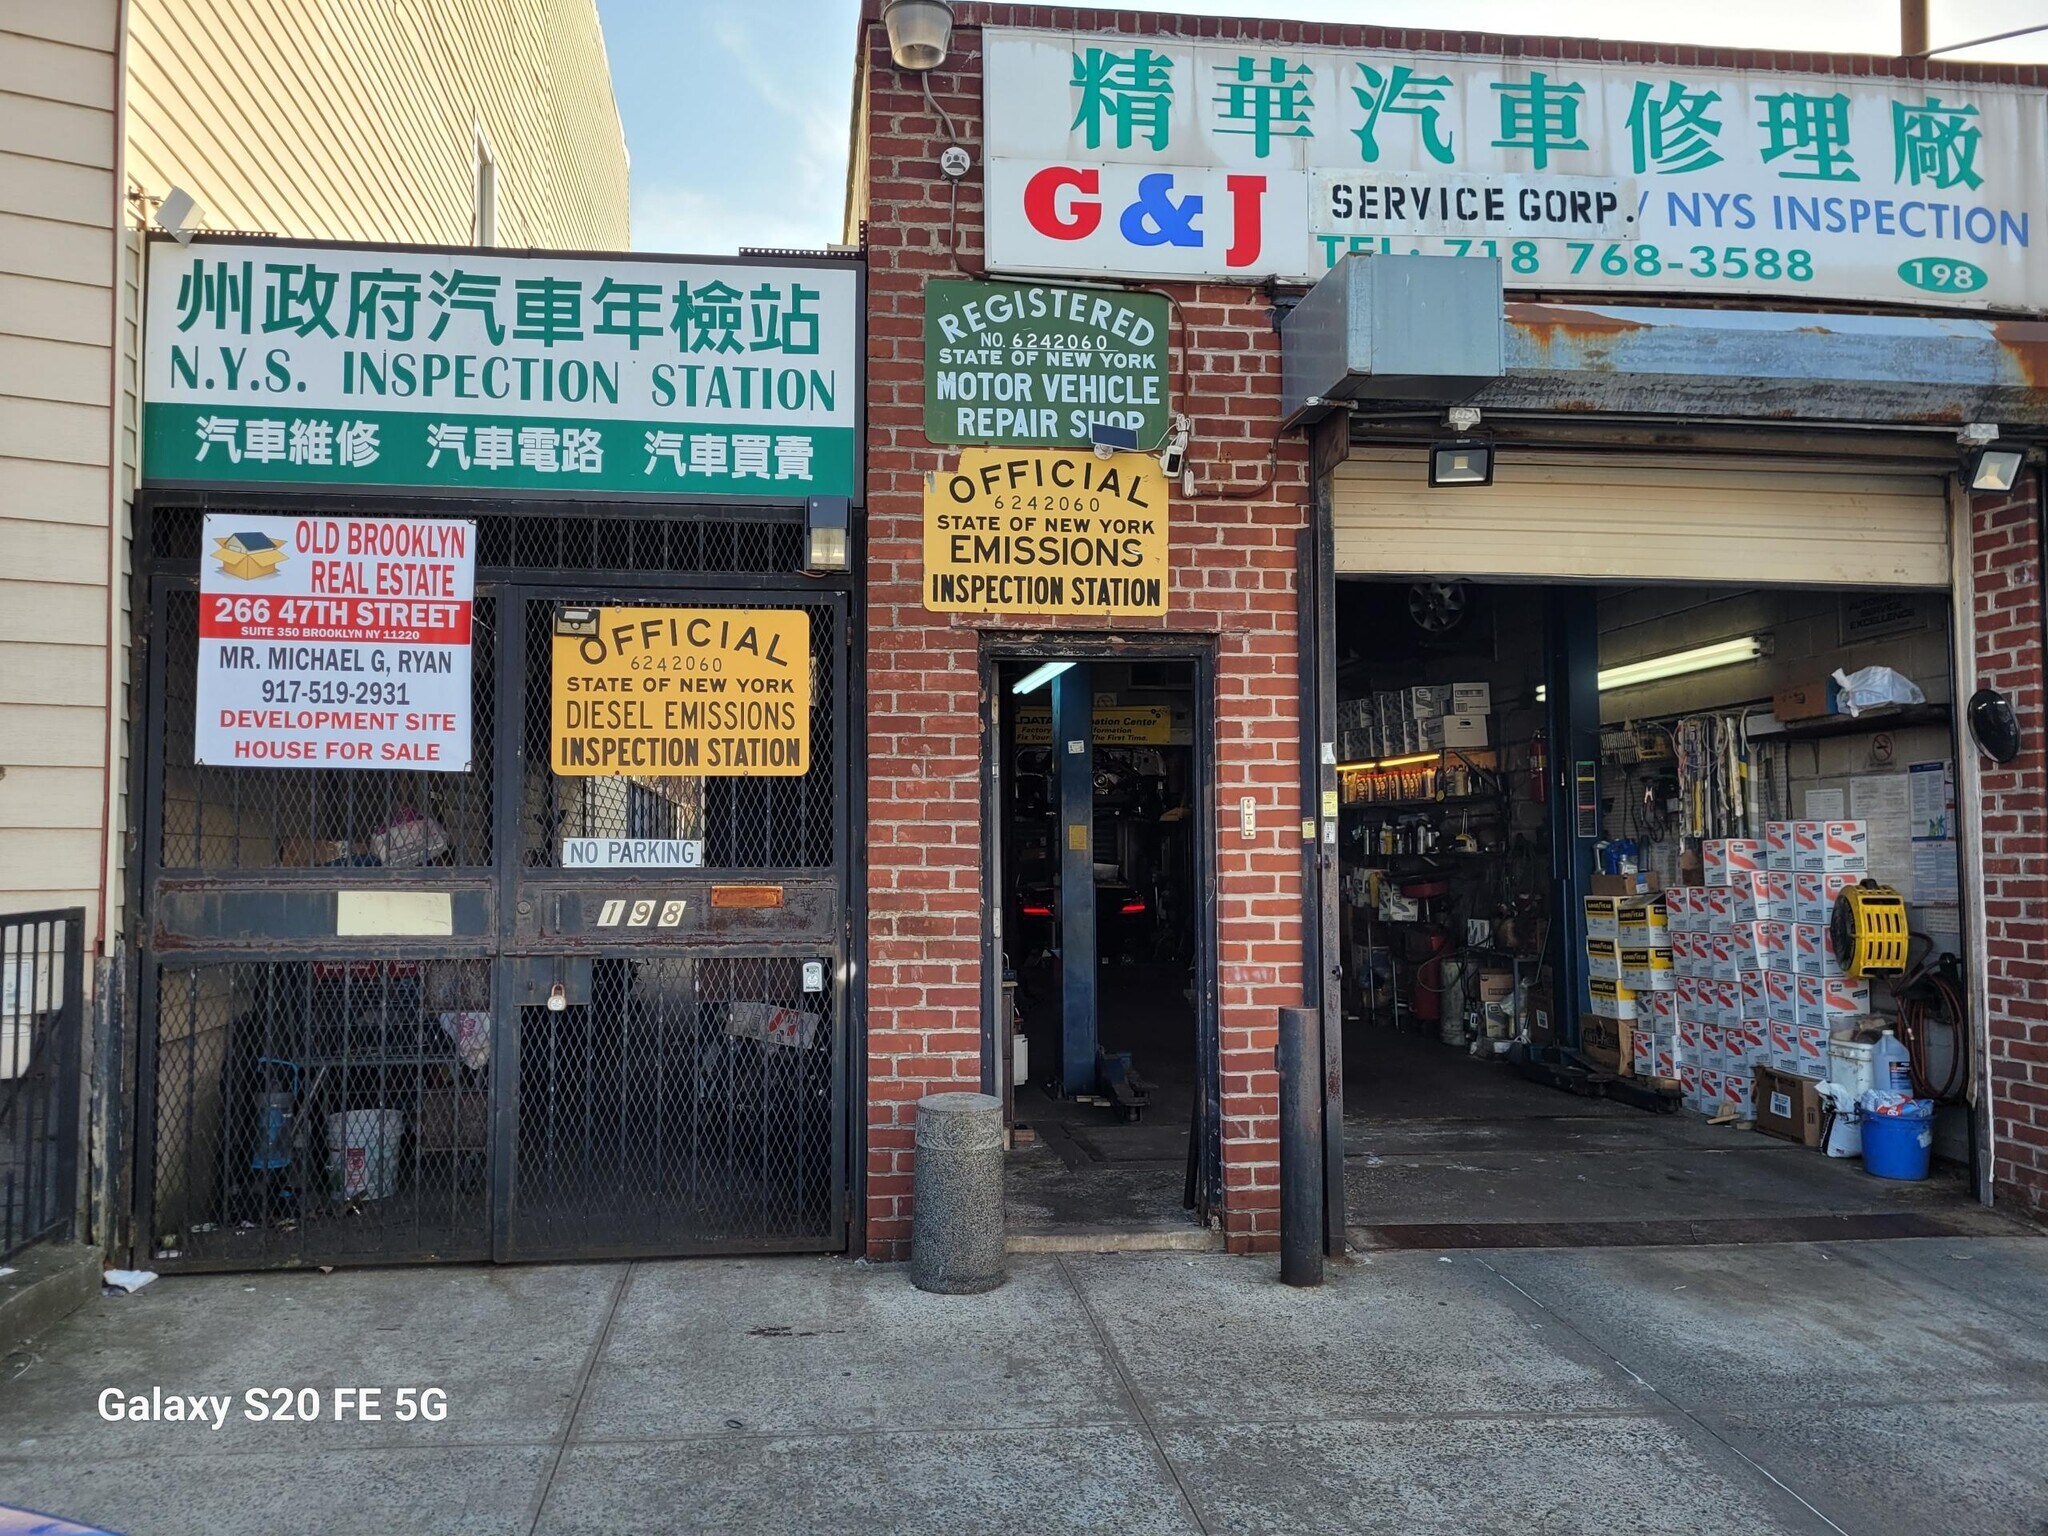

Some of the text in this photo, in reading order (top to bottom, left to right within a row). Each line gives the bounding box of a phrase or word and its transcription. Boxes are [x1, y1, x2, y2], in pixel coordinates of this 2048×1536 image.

[1070, 48, 1985, 191] 精華汽車修理廠
[1024, 166, 1267, 267] G & J
[1331, 184, 1505, 221] SERVICE
[1668, 192, 1756, 230] NYS
[1773, 195, 2030, 248] INSPECTION
[1566, 242, 1814, 282] 768-3588
[1911, 262, 1974, 290] 198
[175, 258, 822, 356] 州政府汽車年檢站
[938, 288, 1155, 347] REGISTERED
[980, 332, 1108, 350] NO. 6242060
[939, 349, 1157, 369] STATE OF NEW YORK
[171, 345, 836, 412] N.Y.S. INSPECTION STATION
[937, 371, 1160, 404] MOTOR VEHICLE
[957, 408, 1058, 438] REPAIR
[195, 415, 815, 481] 汽車維修 汽車電路 汽車買賣
[949, 459, 1150, 509] OFFICIAL
[994, 496, 1100, 513] 6242060
[295, 520, 465, 558] OLD BROOKLYN
[937, 515, 1155, 535] STATE OF NEW YORK
[951, 536, 1143, 568] EMISSIONS
[311, 560, 455, 597] REAL ESTATE
[933, 574, 1160, 607] INSPECTION STATION
[215, 598, 460, 628] 266 47TH STREET
[241, 627, 420, 640] SUITE 350 BROOKLYN NY 11220
[580, 618, 788, 667] OFFICIAL
[220, 646, 452, 677] MR. MICHAEL G, RYAN
[630, 656, 722, 672] 6242060
[262, 680, 410, 705] 917-519-2931
[567, 676, 795, 694] STATE OF NEW YORK
[220, 710, 456, 731] DEVELOPMENT SITE
[566, 700, 796, 730] DIESEL EMISSIONS
[1124, 718, 1158, 726] Center
[234, 740, 441, 761] HOUSE FOR SALE
[561, 737, 800, 767] INSPECTION STATION
[570, 842, 695, 863] NO PARKING
[602, 901, 682, 925] 198
